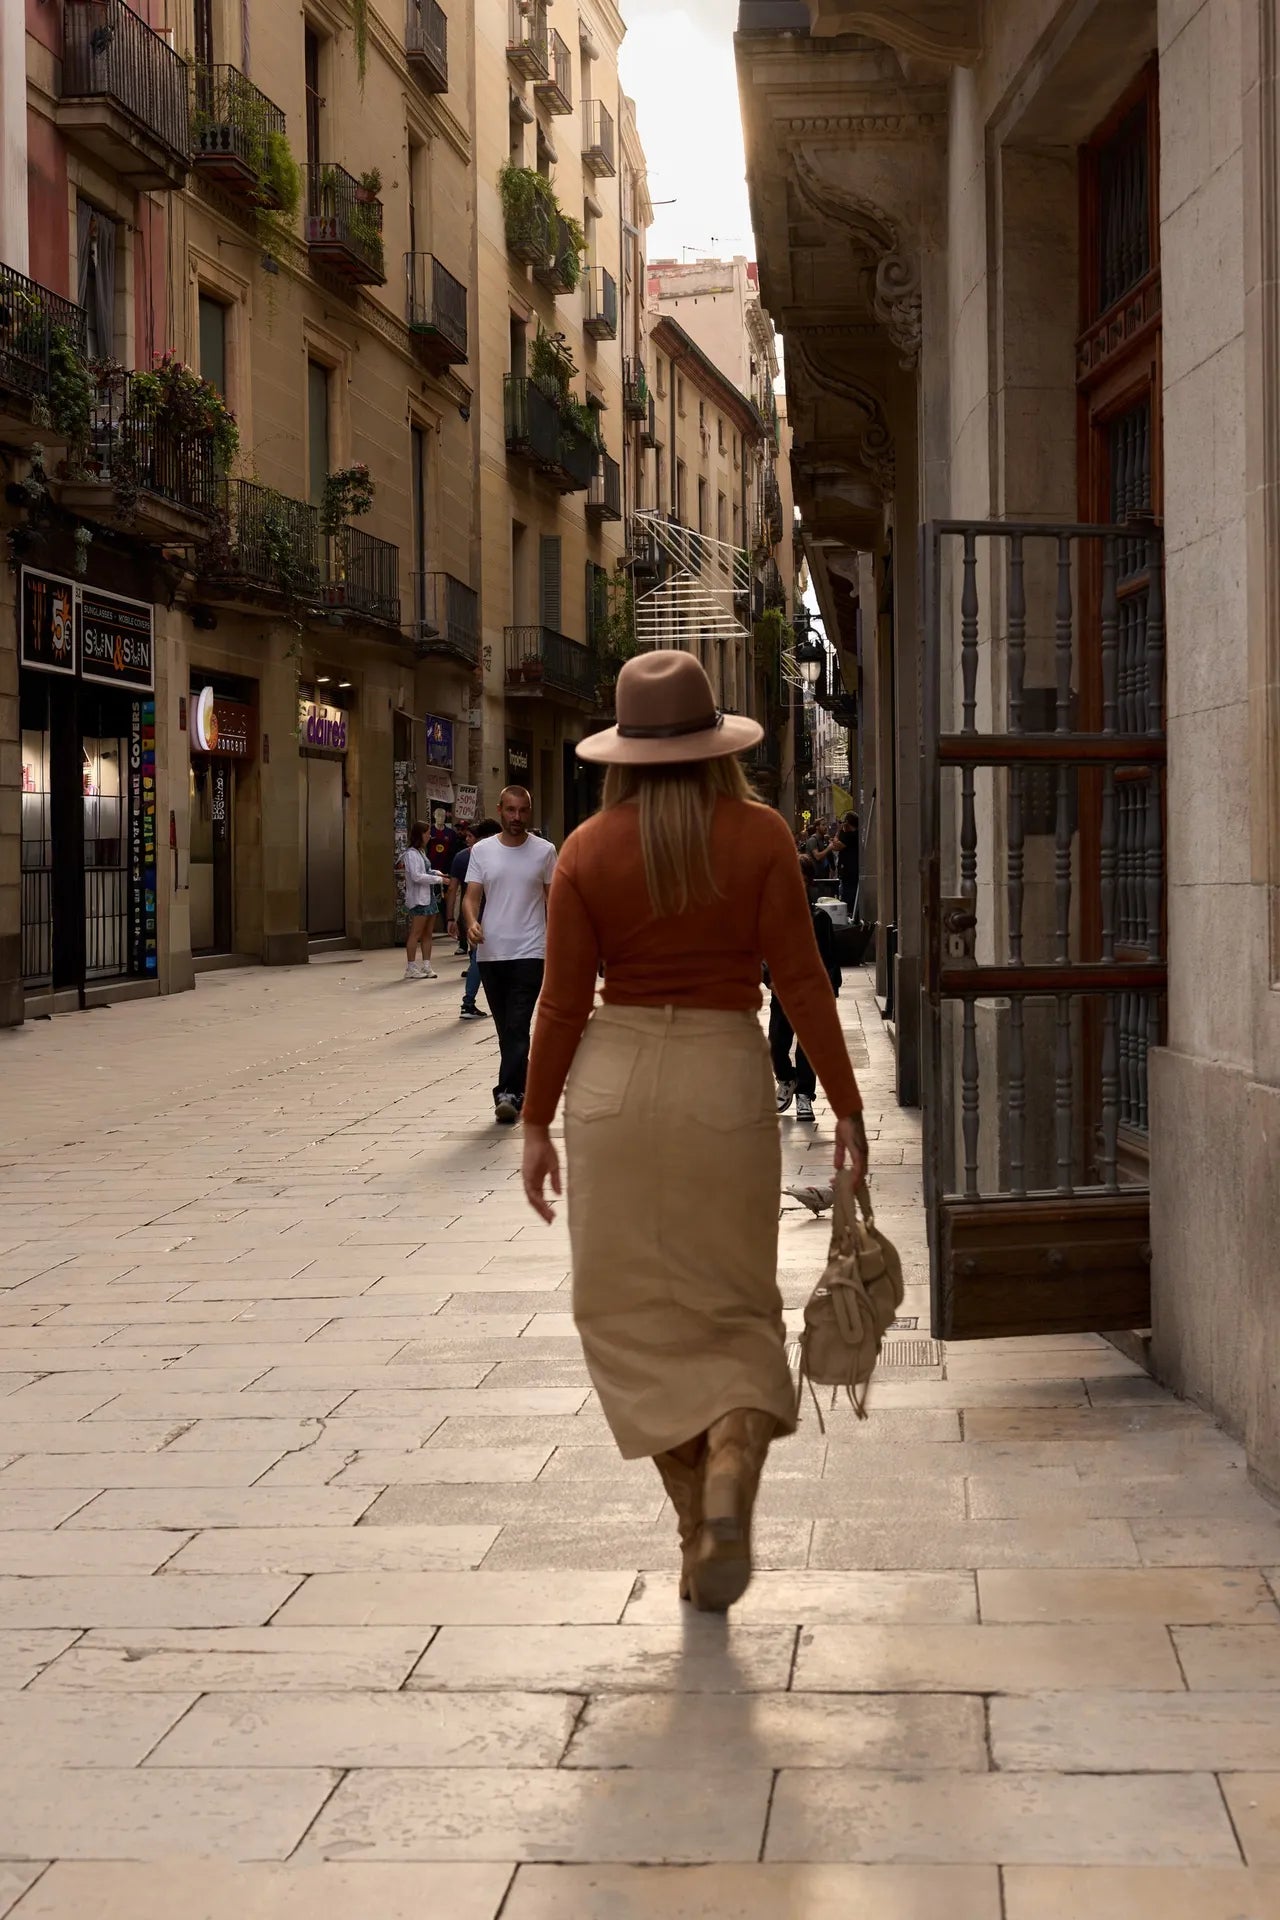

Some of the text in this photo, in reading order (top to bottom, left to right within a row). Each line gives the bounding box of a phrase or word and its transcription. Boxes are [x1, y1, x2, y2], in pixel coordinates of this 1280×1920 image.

[83, 604, 113, 620] SUNGLASSES
[118, 614, 134, 626] MOBILE
[134, 617, 150, 630] COVERS
[130, 701, 141, 768] COVERS
[218, 738, 247, 755] concept
